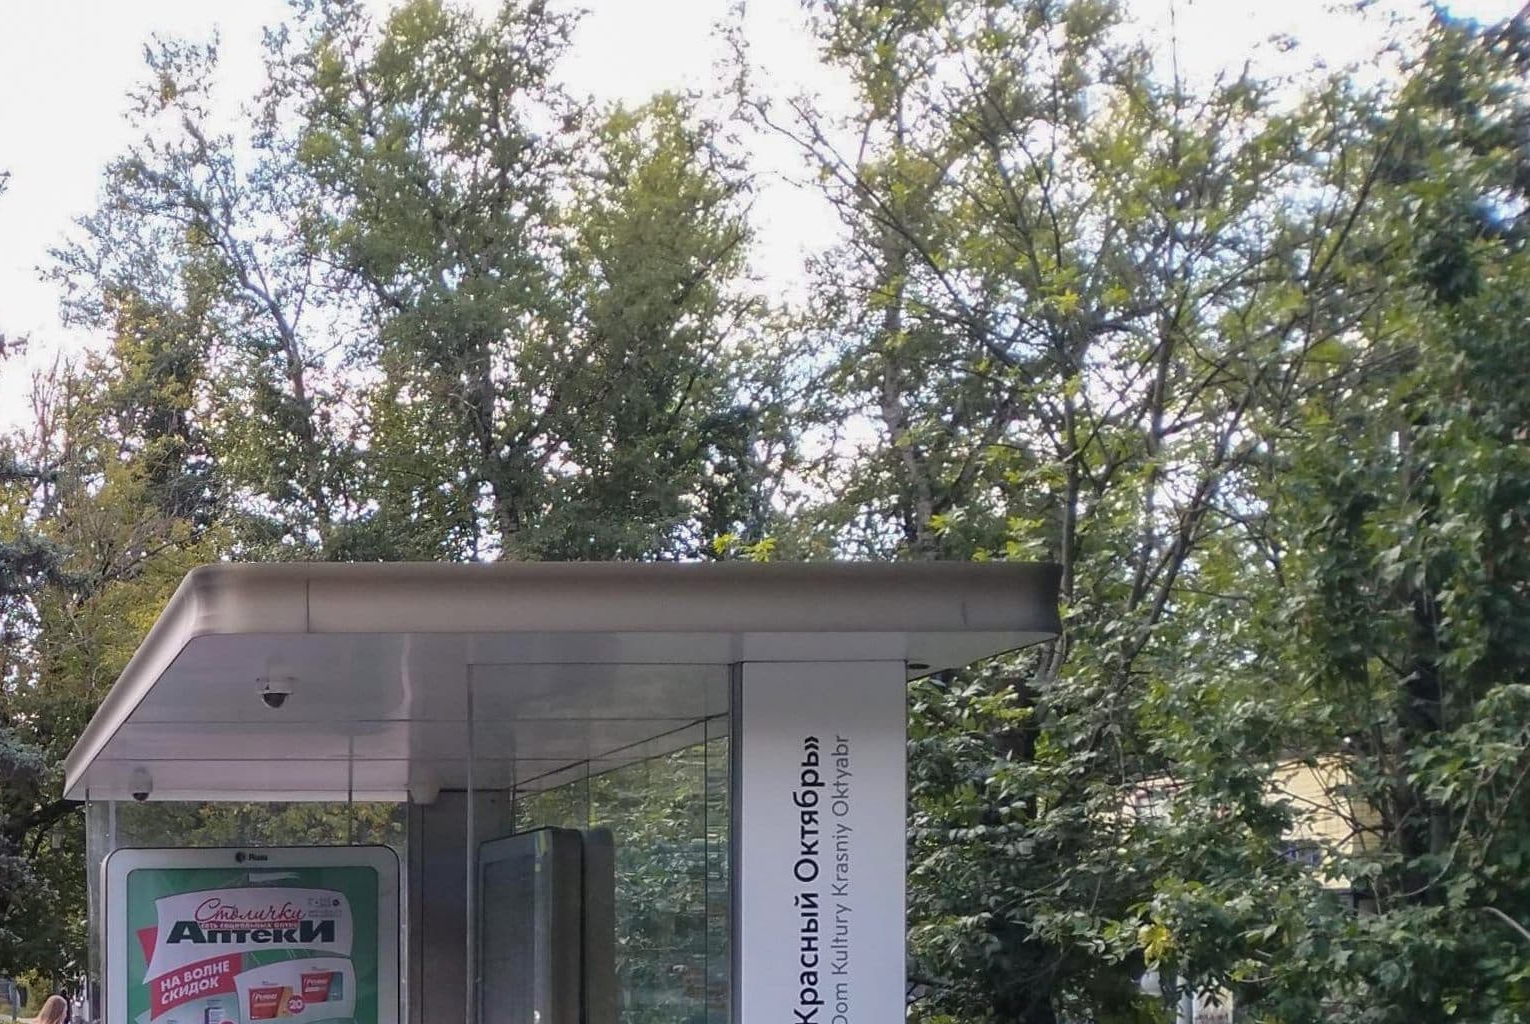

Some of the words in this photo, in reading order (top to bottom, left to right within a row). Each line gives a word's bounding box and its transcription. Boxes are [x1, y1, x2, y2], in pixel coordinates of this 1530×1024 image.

[830, 734, 854, 817] Oktyabr
[793, 735, 826, 883] Октябрь»
[830, 820, 854, 898] Krasniy
[194, 898, 305, 922] Столички
[830, 903, 854, 976] Kultury
[160, 976, 181, 992] НА
[183, 960, 230, 983] ВОЛНЕ
[160, 976, 220, 1005] СКИДОК
[289, 999, 303, 1010] 20
